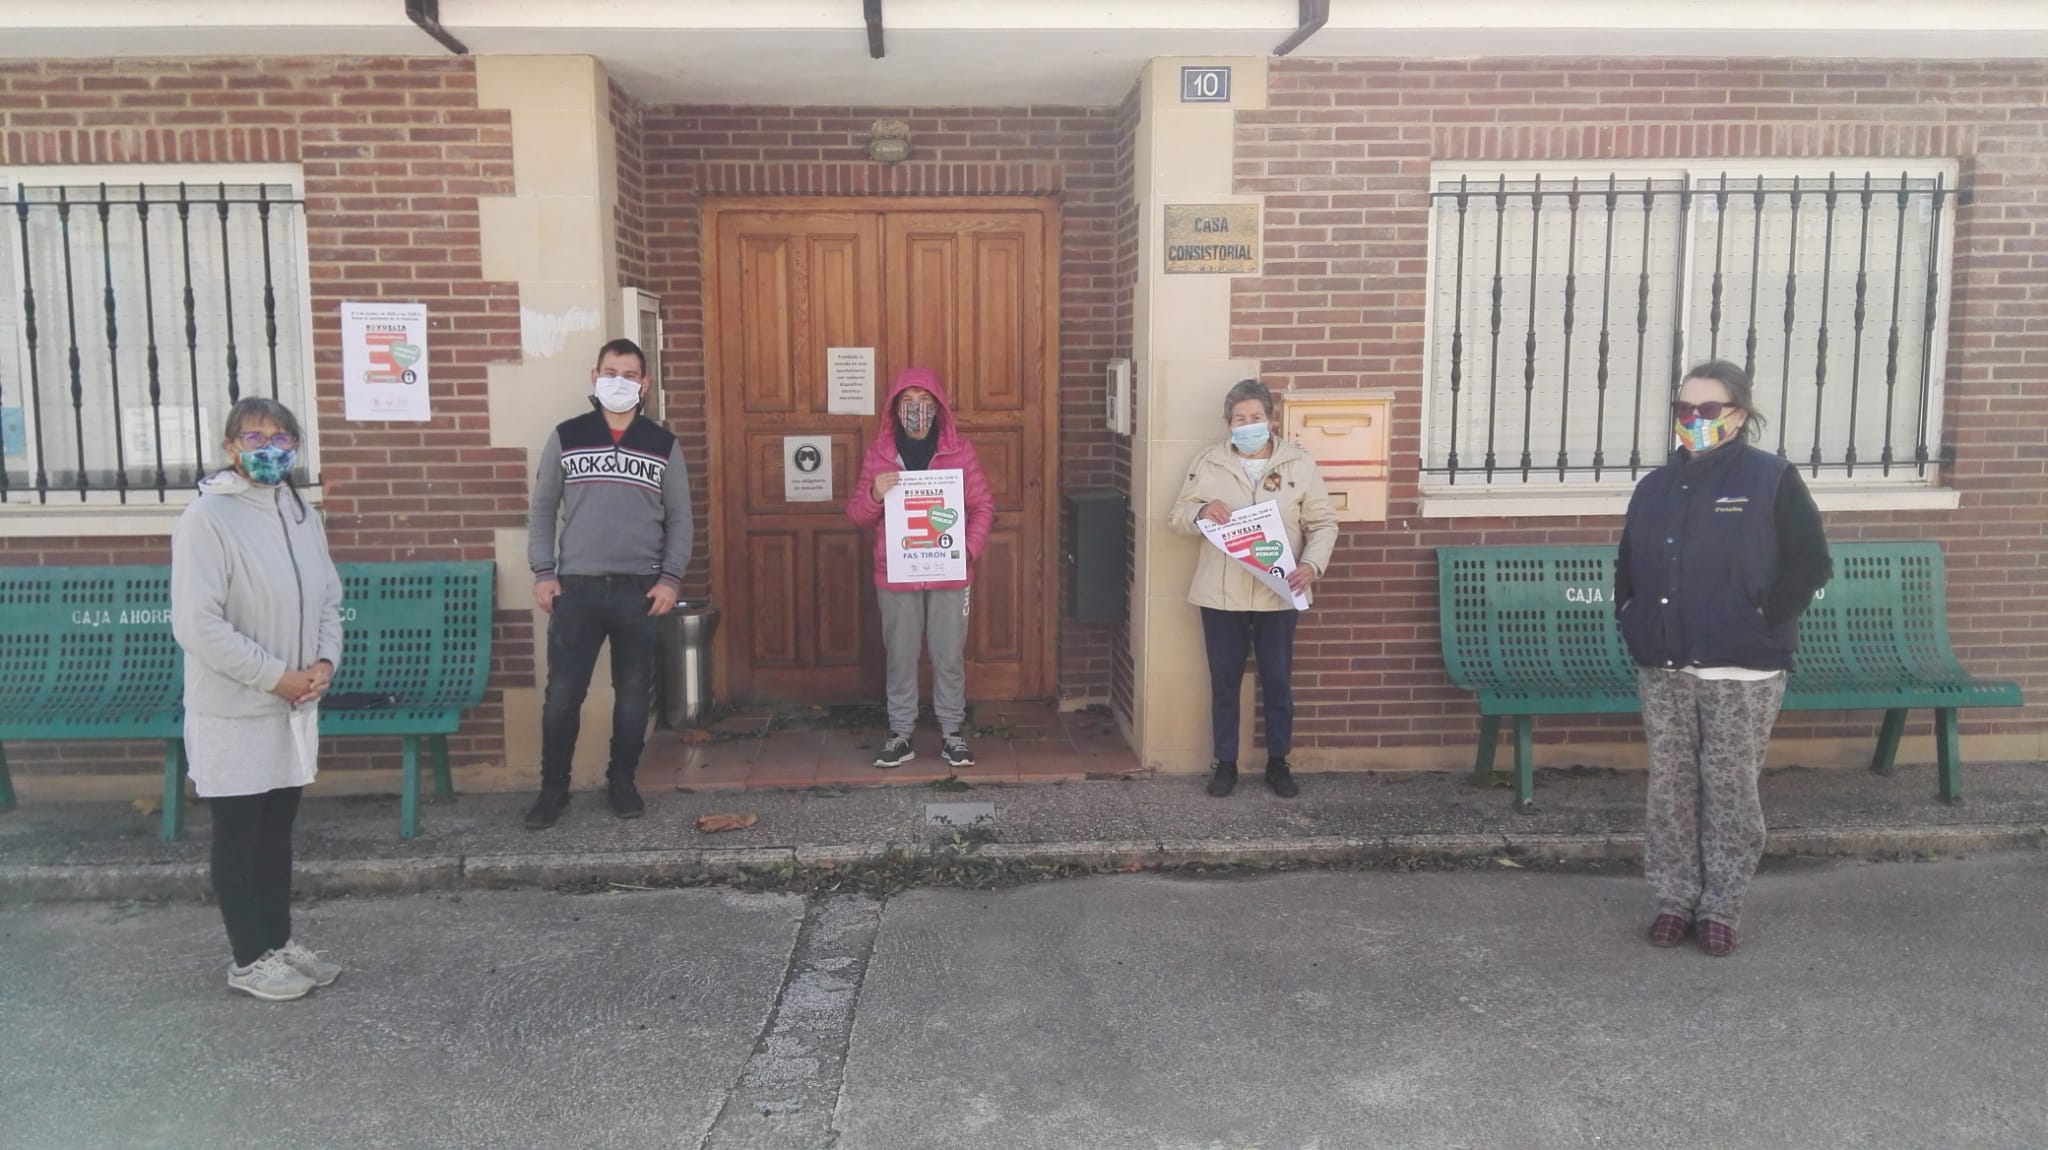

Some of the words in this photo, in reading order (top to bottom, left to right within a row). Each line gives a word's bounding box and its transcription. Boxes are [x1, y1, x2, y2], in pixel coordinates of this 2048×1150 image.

[1194, 72, 1218, 97] 10
[1194, 217, 1229, 233] CASA
[1168, 244, 1253, 261] CONSISTORIAL
[1566, 588, 1603, 604] CAJA
[72, 610, 111, 627] CAJA
[119, 609, 173, 624] AHORR
